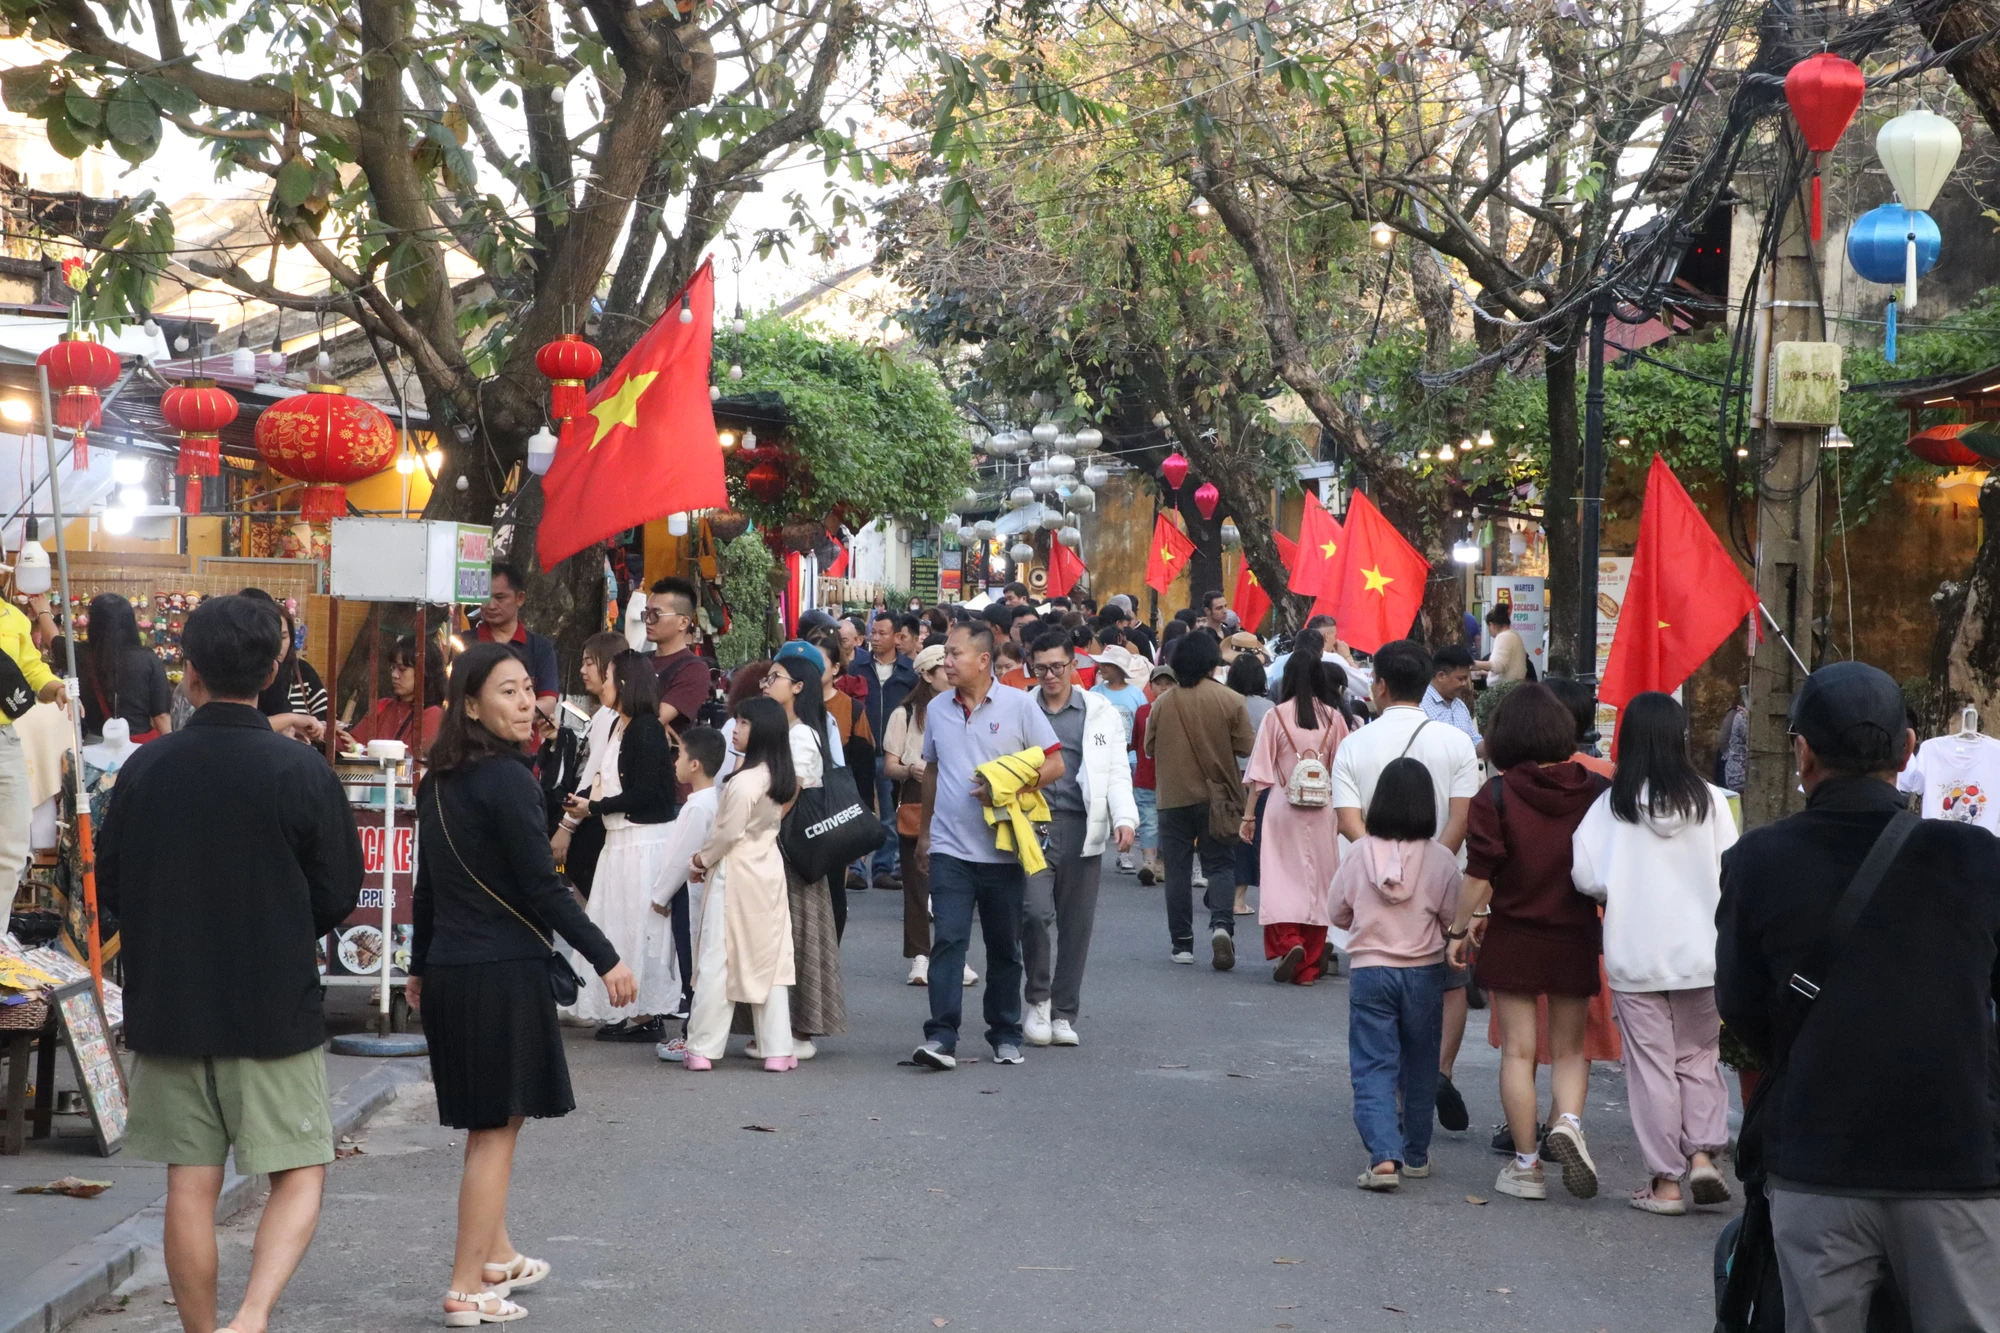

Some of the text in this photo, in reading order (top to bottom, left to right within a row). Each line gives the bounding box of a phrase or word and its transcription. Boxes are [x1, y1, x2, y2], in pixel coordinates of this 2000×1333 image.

[1514, 584, 1535, 592] WARTER
[1513, 613, 1529, 621] PEPSI
[1093, 733, 1107, 746] NY
[804, 803, 864, 839] CONVERSE
